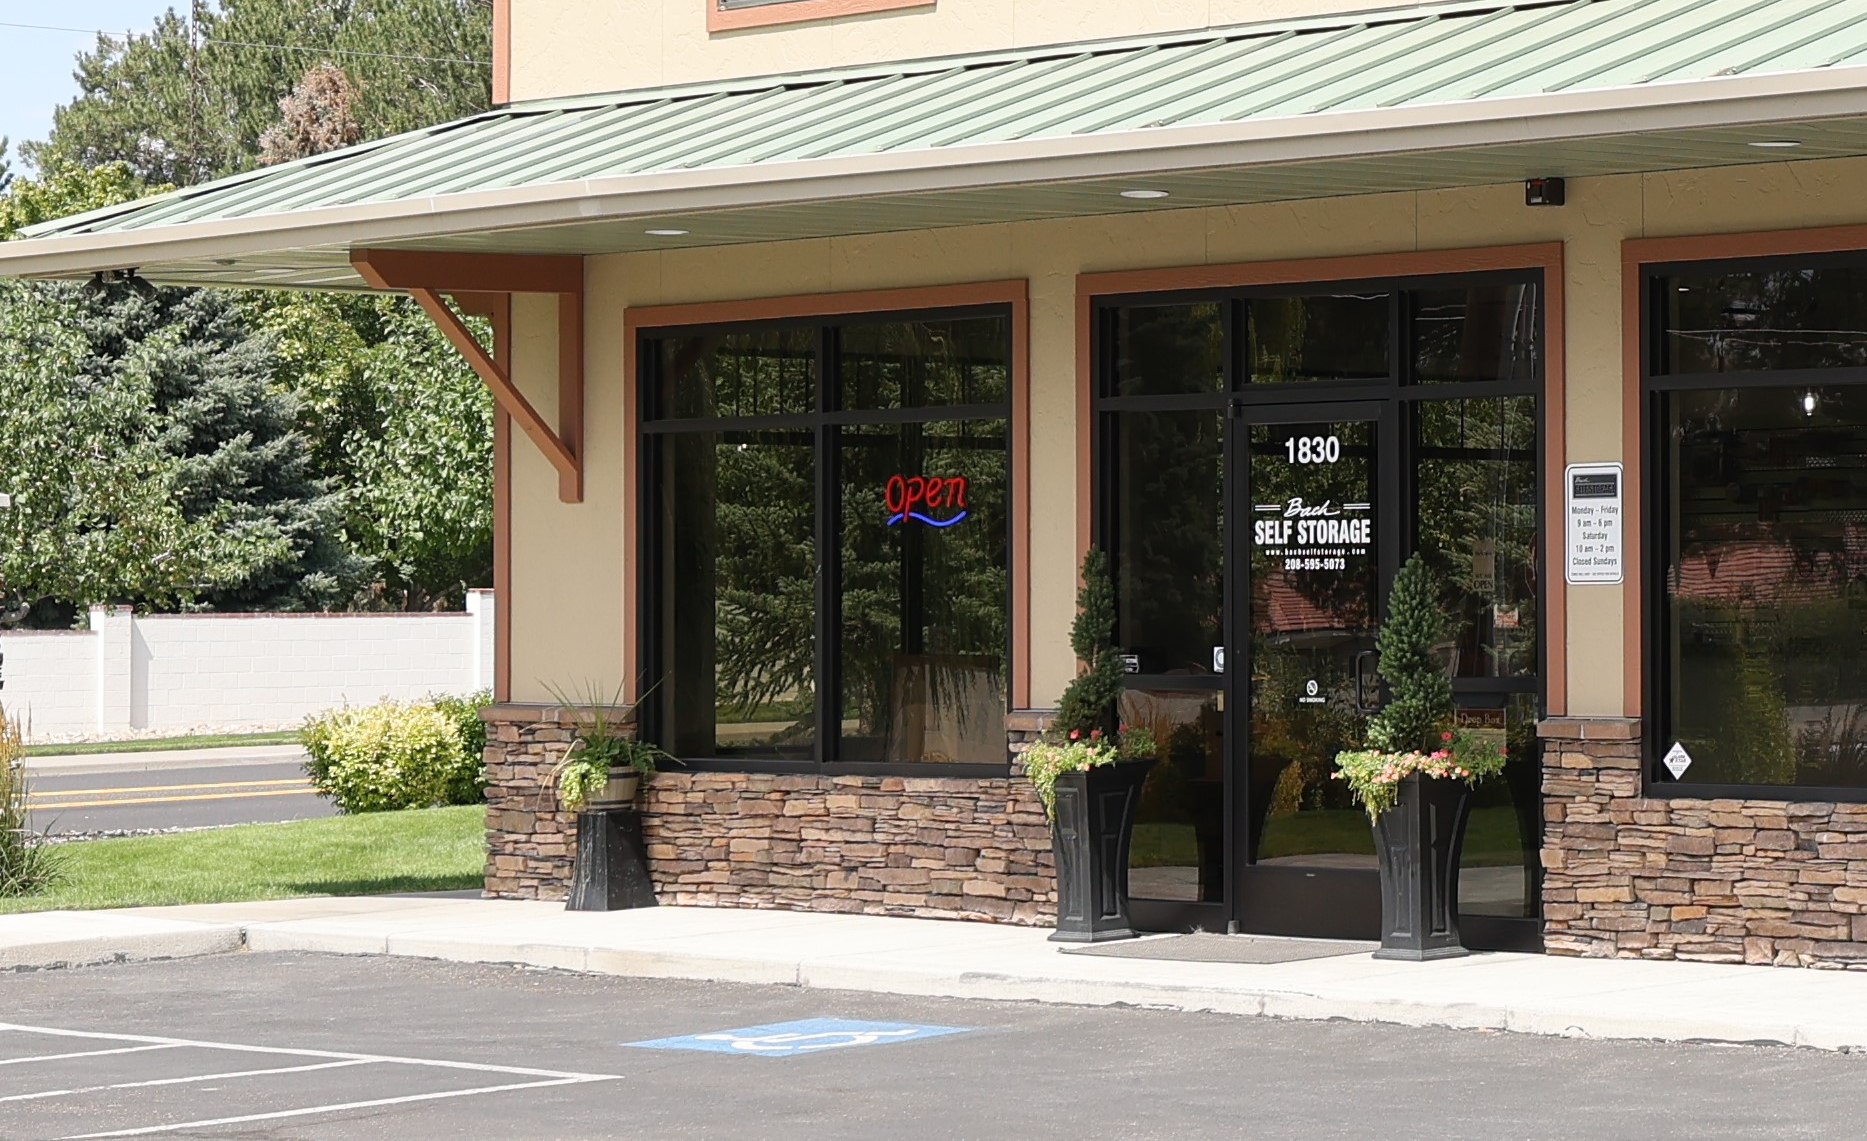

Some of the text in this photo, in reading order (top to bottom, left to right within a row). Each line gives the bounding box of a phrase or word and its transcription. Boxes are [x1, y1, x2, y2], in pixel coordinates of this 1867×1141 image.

[1285, 436, 1340, 464] 1830
[885, 475, 967, 523] Open
[1284, 498, 1340, 517] Bach
[1572, 506, 1594, 516] Monday
[1601, 505, 1618, 515] Friday
[1604, 520, 1612, 528] pm
[1255, 519, 1371, 545] SELF STORAGE
[1582, 532, 1608, 541] Saturday
[1576, 544, 1583, 553] 10
[1600, 544, 1604, 552] 2
[1605, 545, 1614, 553] pm
[1285, 558, 1345, 570] 208-595-5073
[1572, 557, 1617, 566] Closed Sundays
